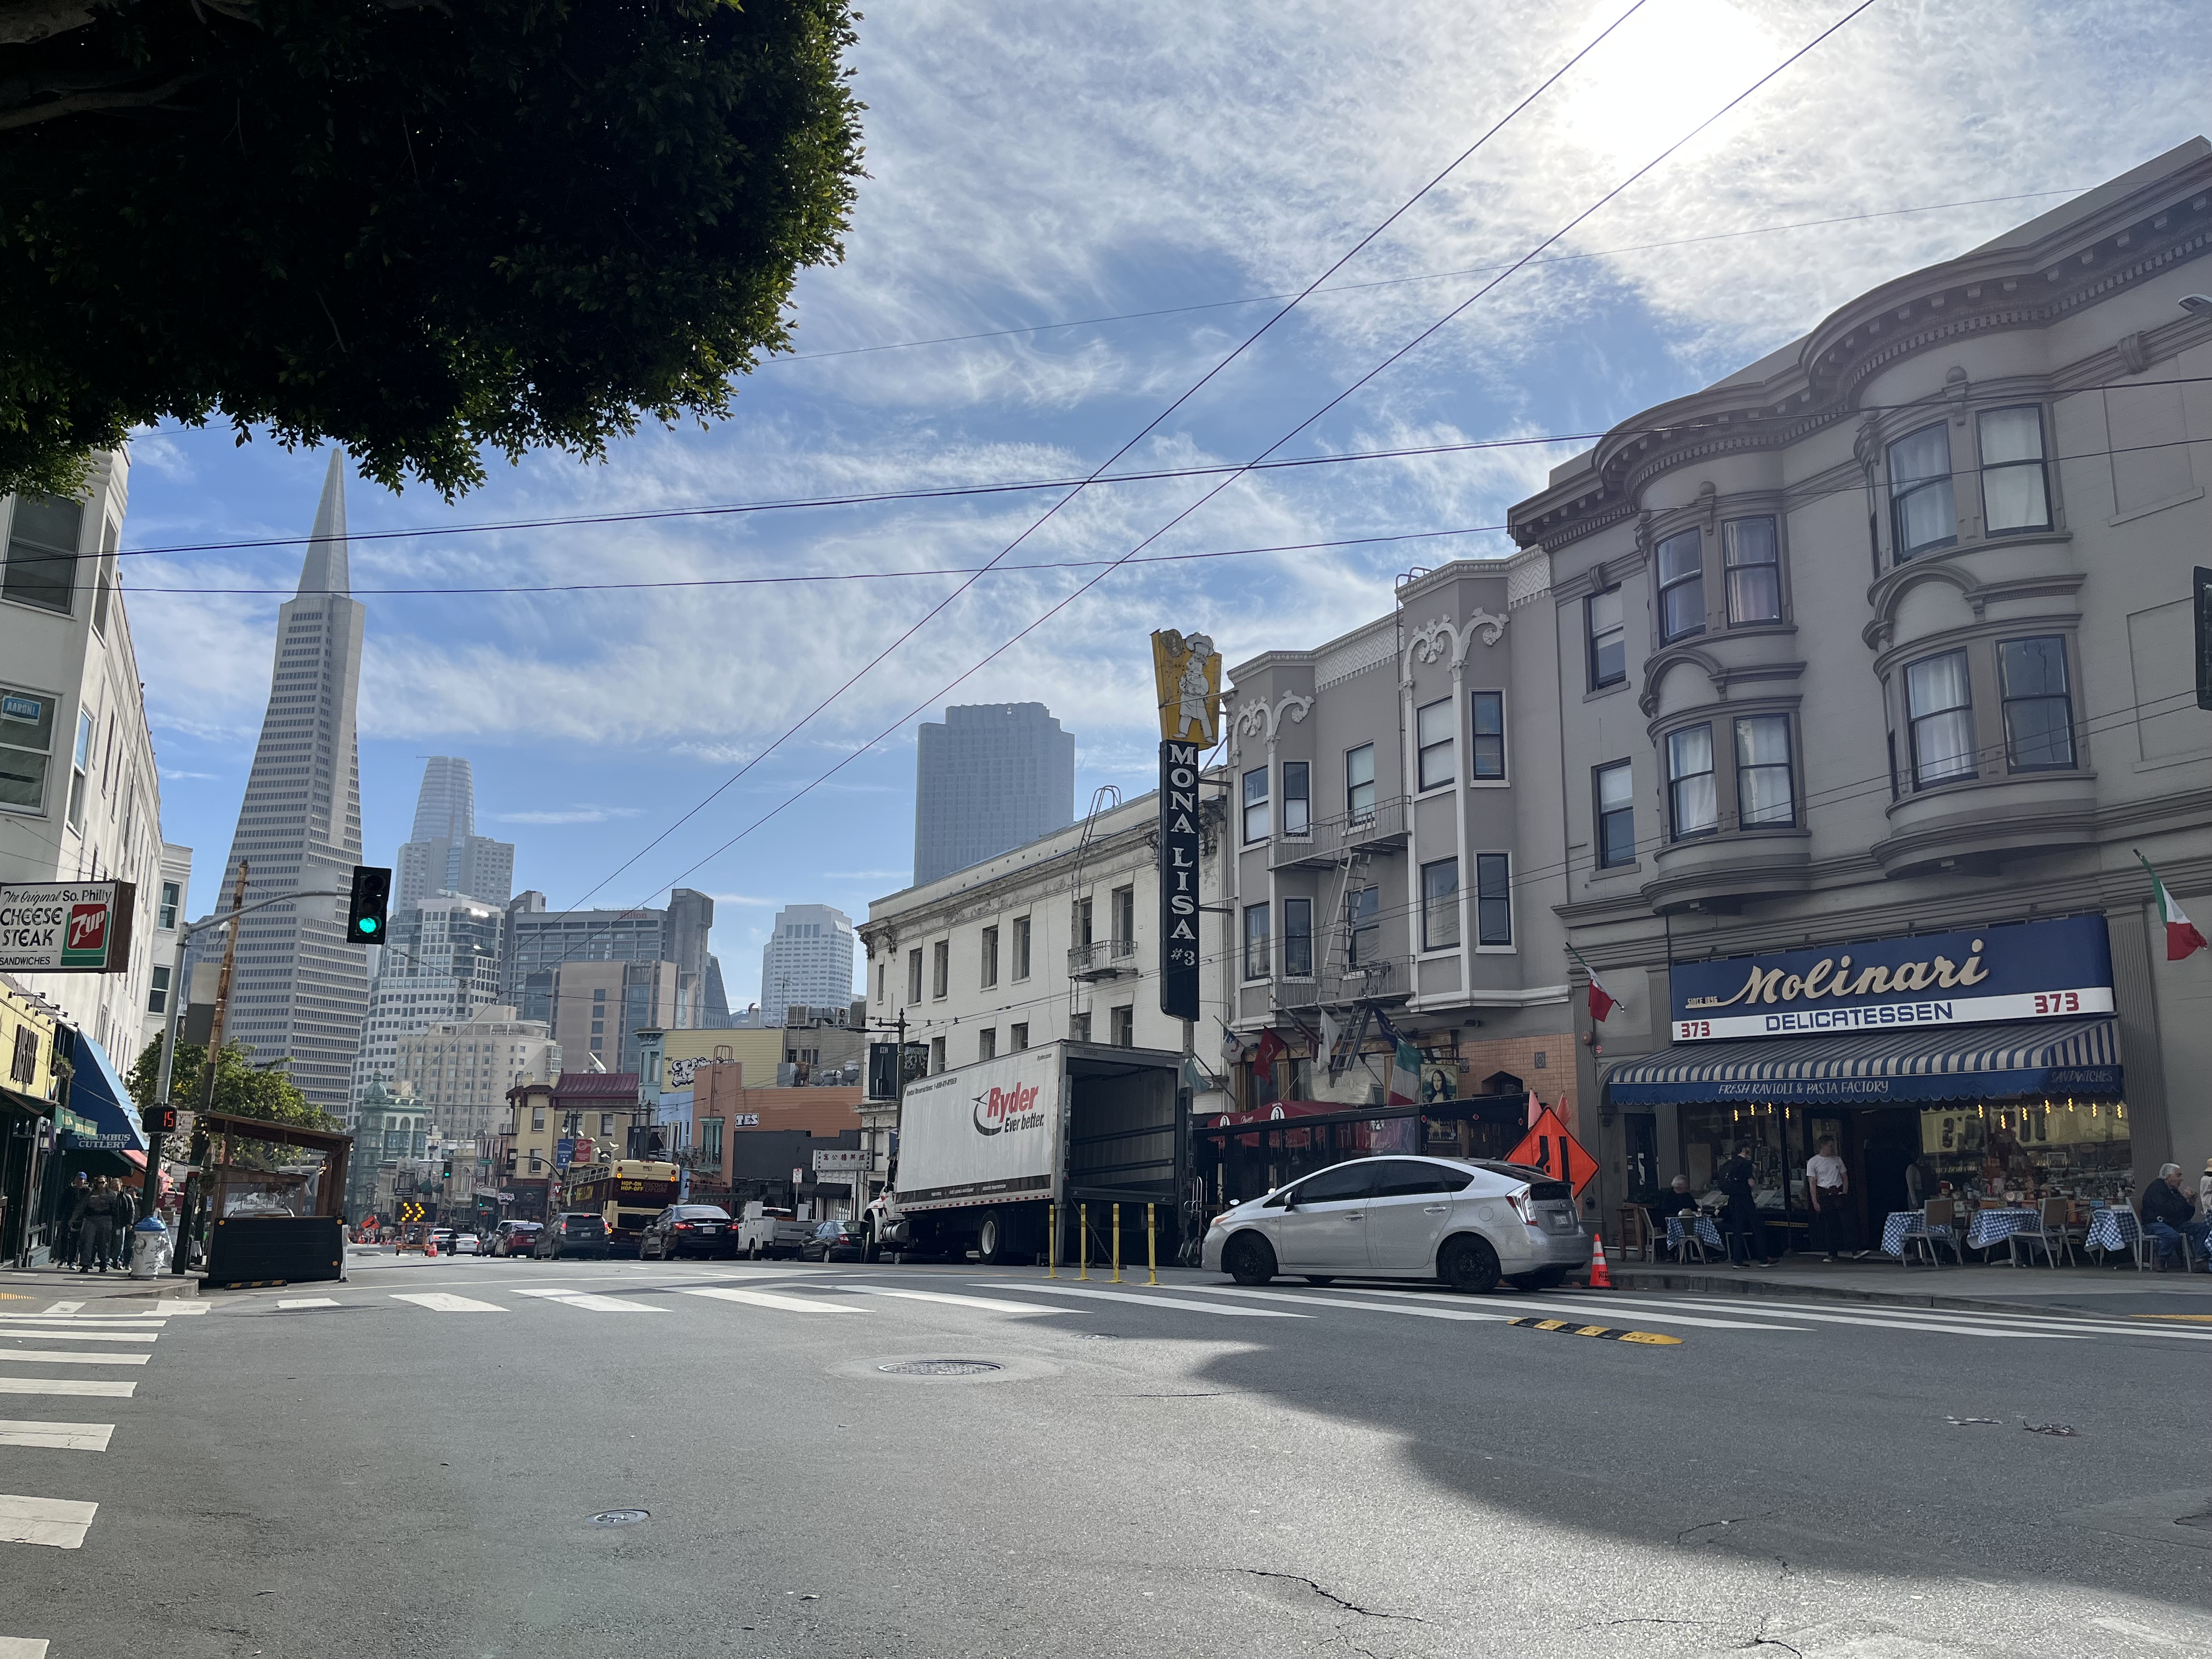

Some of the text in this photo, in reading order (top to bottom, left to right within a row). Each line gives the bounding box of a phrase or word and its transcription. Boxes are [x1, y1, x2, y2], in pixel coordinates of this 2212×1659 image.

[7, 702, 35, 715] AARON!
[1169, 744, 1196, 939] MONA LISA
[4, 889, 112, 906] The Original So. Philly
[1, 907, 63, 926] CHEESE
[2, 929, 55, 946] STEAK
[0, 956, 50, 966] SANDWICHES
[1171, 948, 1195, 966] #3
[1685, 939, 1989, 1008] Molinari
[1688, 996, 1718, 1005] SINCE 1896
[2035, 992, 2079, 1014] 373
[1766, 1002, 1953, 1031] DELICATESSEN
[1681, 1021, 1711, 1038] 373
[2050, 1070, 2113, 1083] SANDWICHES
[1718, 1081, 1889, 1094] FRESH RAVIOLI & PASTA FACTORY
[987, 1082, 1039, 1123] Ryder
[163, 1111, 173, 1127] 15
[736, 1114, 759, 1127] TES
[1005, 1113, 1044, 1133] Ever better.
